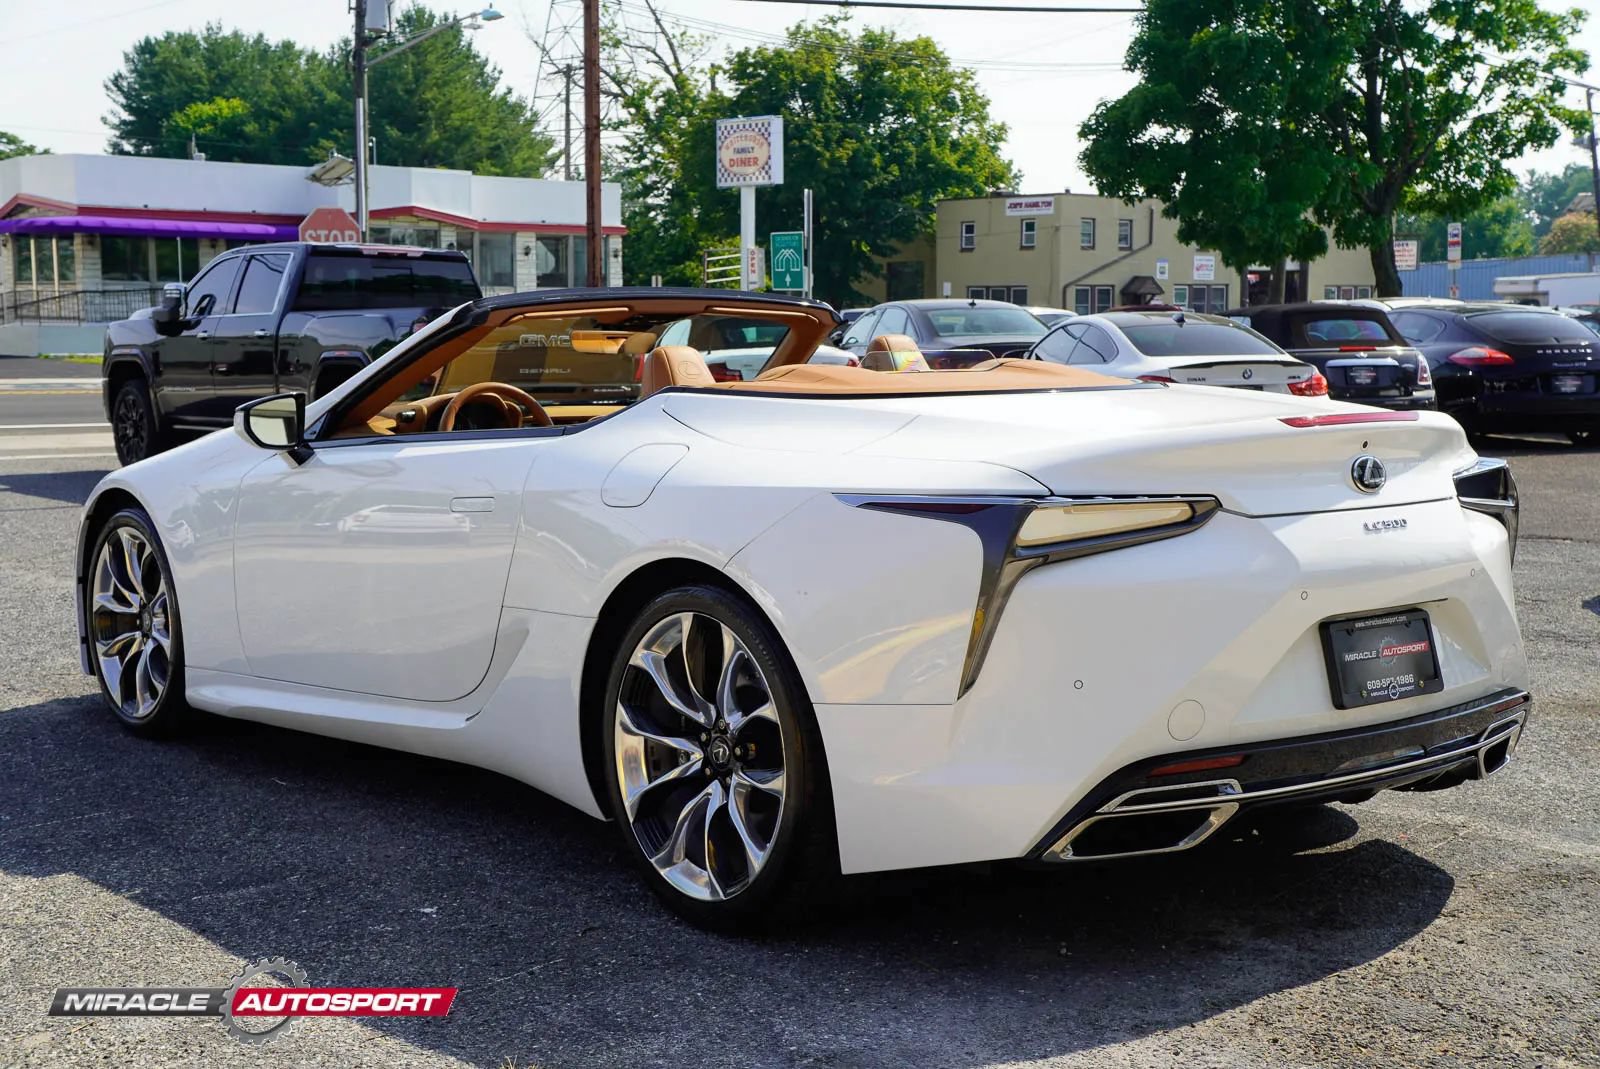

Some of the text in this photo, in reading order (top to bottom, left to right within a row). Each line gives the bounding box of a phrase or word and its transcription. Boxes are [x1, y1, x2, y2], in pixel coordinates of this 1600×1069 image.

[733, 146, 755, 155] FAMILY
[728, 157, 760, 168] DINER
[305, 230, 357, 243] STOP
[519, 333, 570, 348] GMC
[1344, 643, 1426, 662] MIRACLE AUTOSPORT
